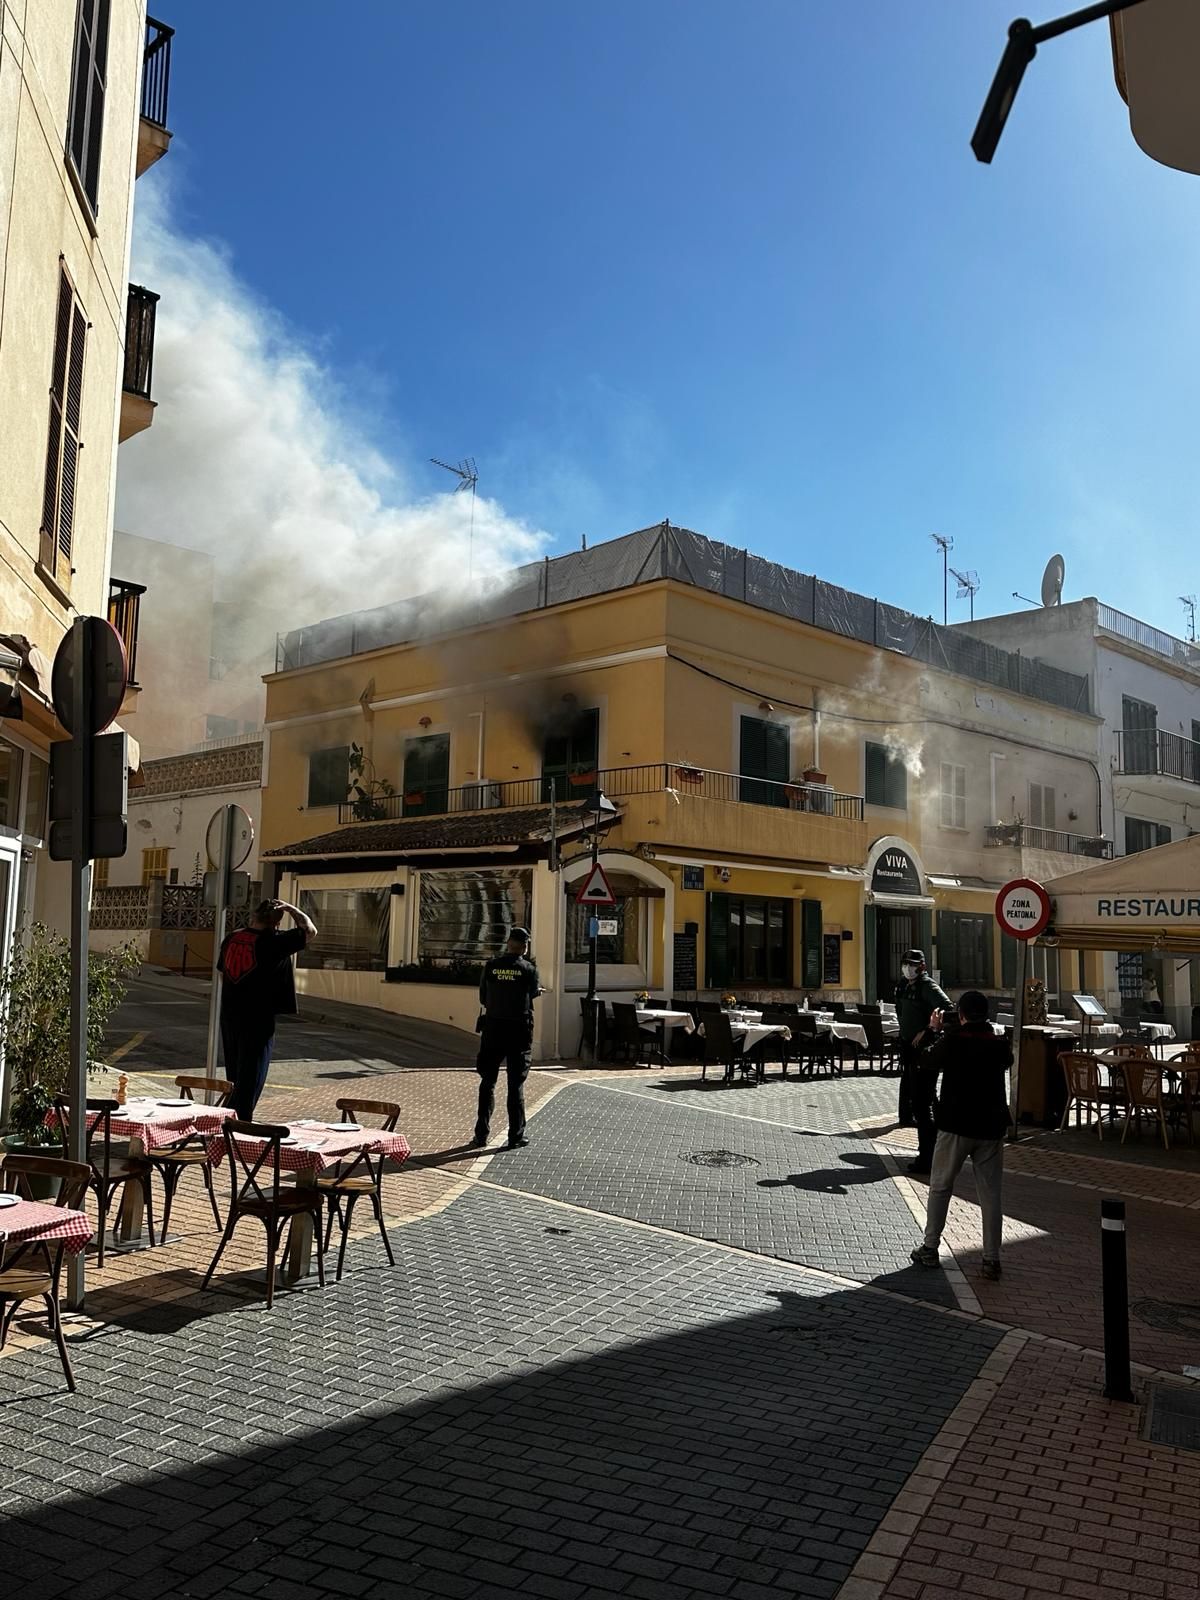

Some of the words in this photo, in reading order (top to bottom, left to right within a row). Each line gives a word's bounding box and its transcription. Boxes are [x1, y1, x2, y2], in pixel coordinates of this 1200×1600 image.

[885, 855, 908, 869] VIVA
[1012, 900, 1031, 908] ZONA
[1098, 899, 1200, 917] RESTAUR
[1007, 910, 1037, 919] PEATONAL
